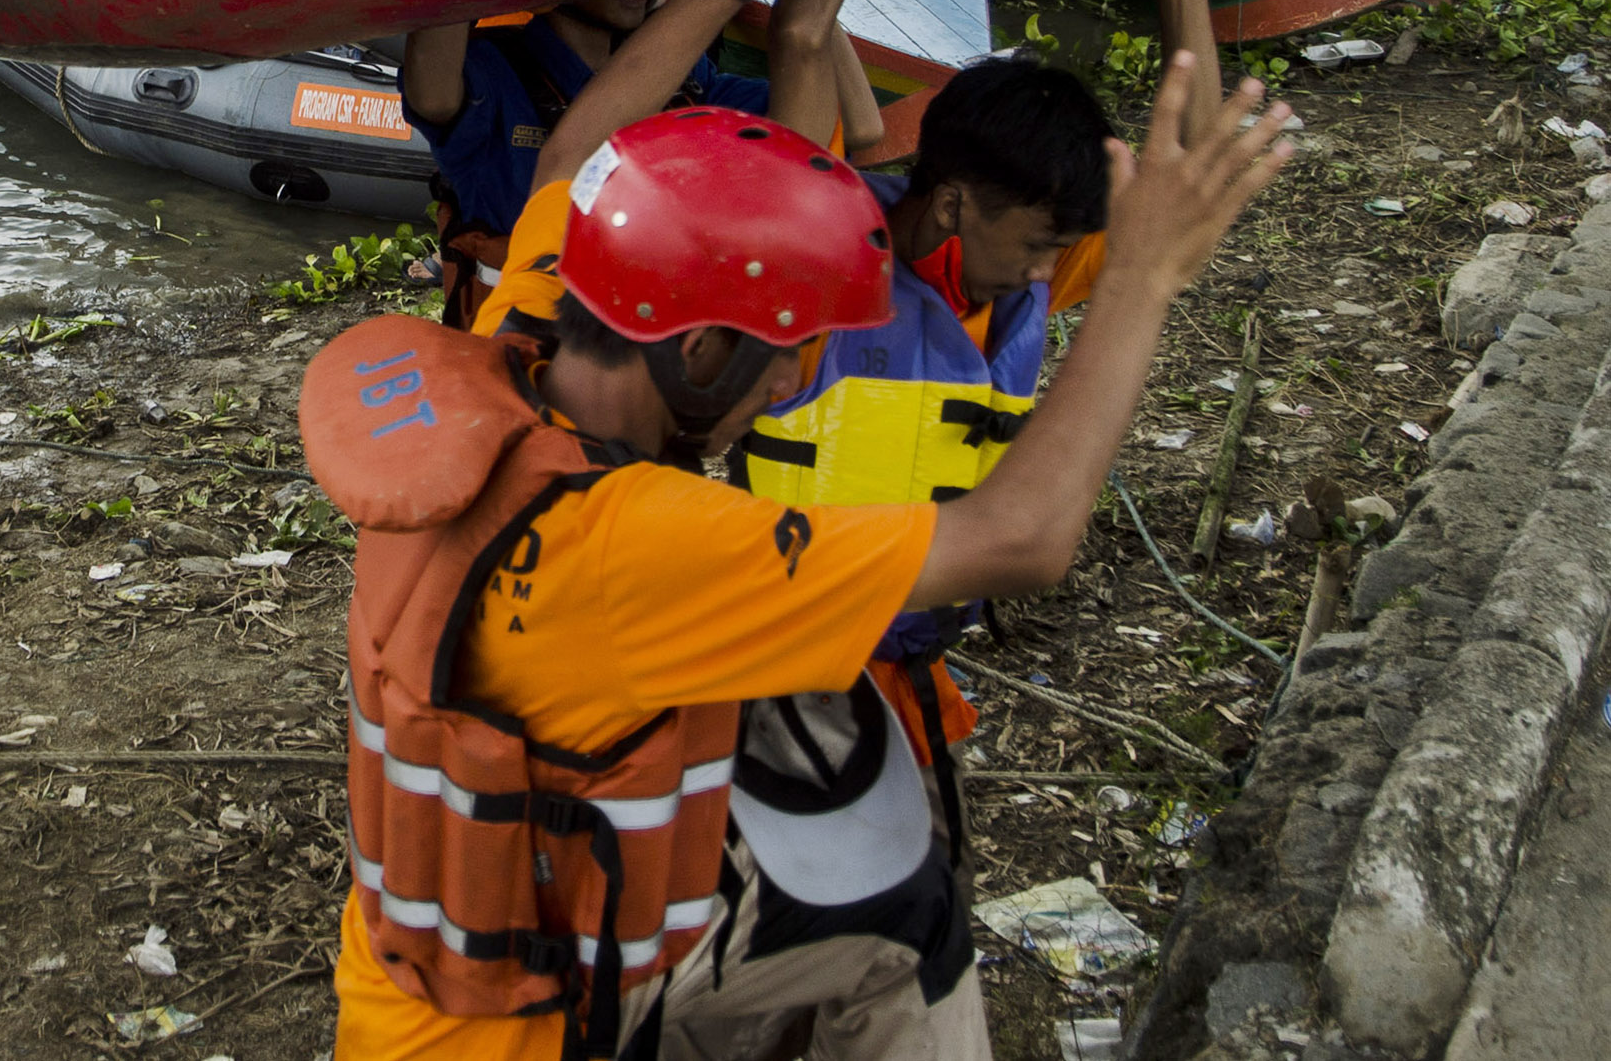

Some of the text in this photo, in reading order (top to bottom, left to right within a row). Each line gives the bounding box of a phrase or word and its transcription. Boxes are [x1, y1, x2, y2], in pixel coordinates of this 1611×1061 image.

[298, 89, 340, 122] PROGRAM
[337, 94, 356, 124] CSR
[357, 96, 384, 128] FAJAR
[355, 349, 437, 438] JBT
